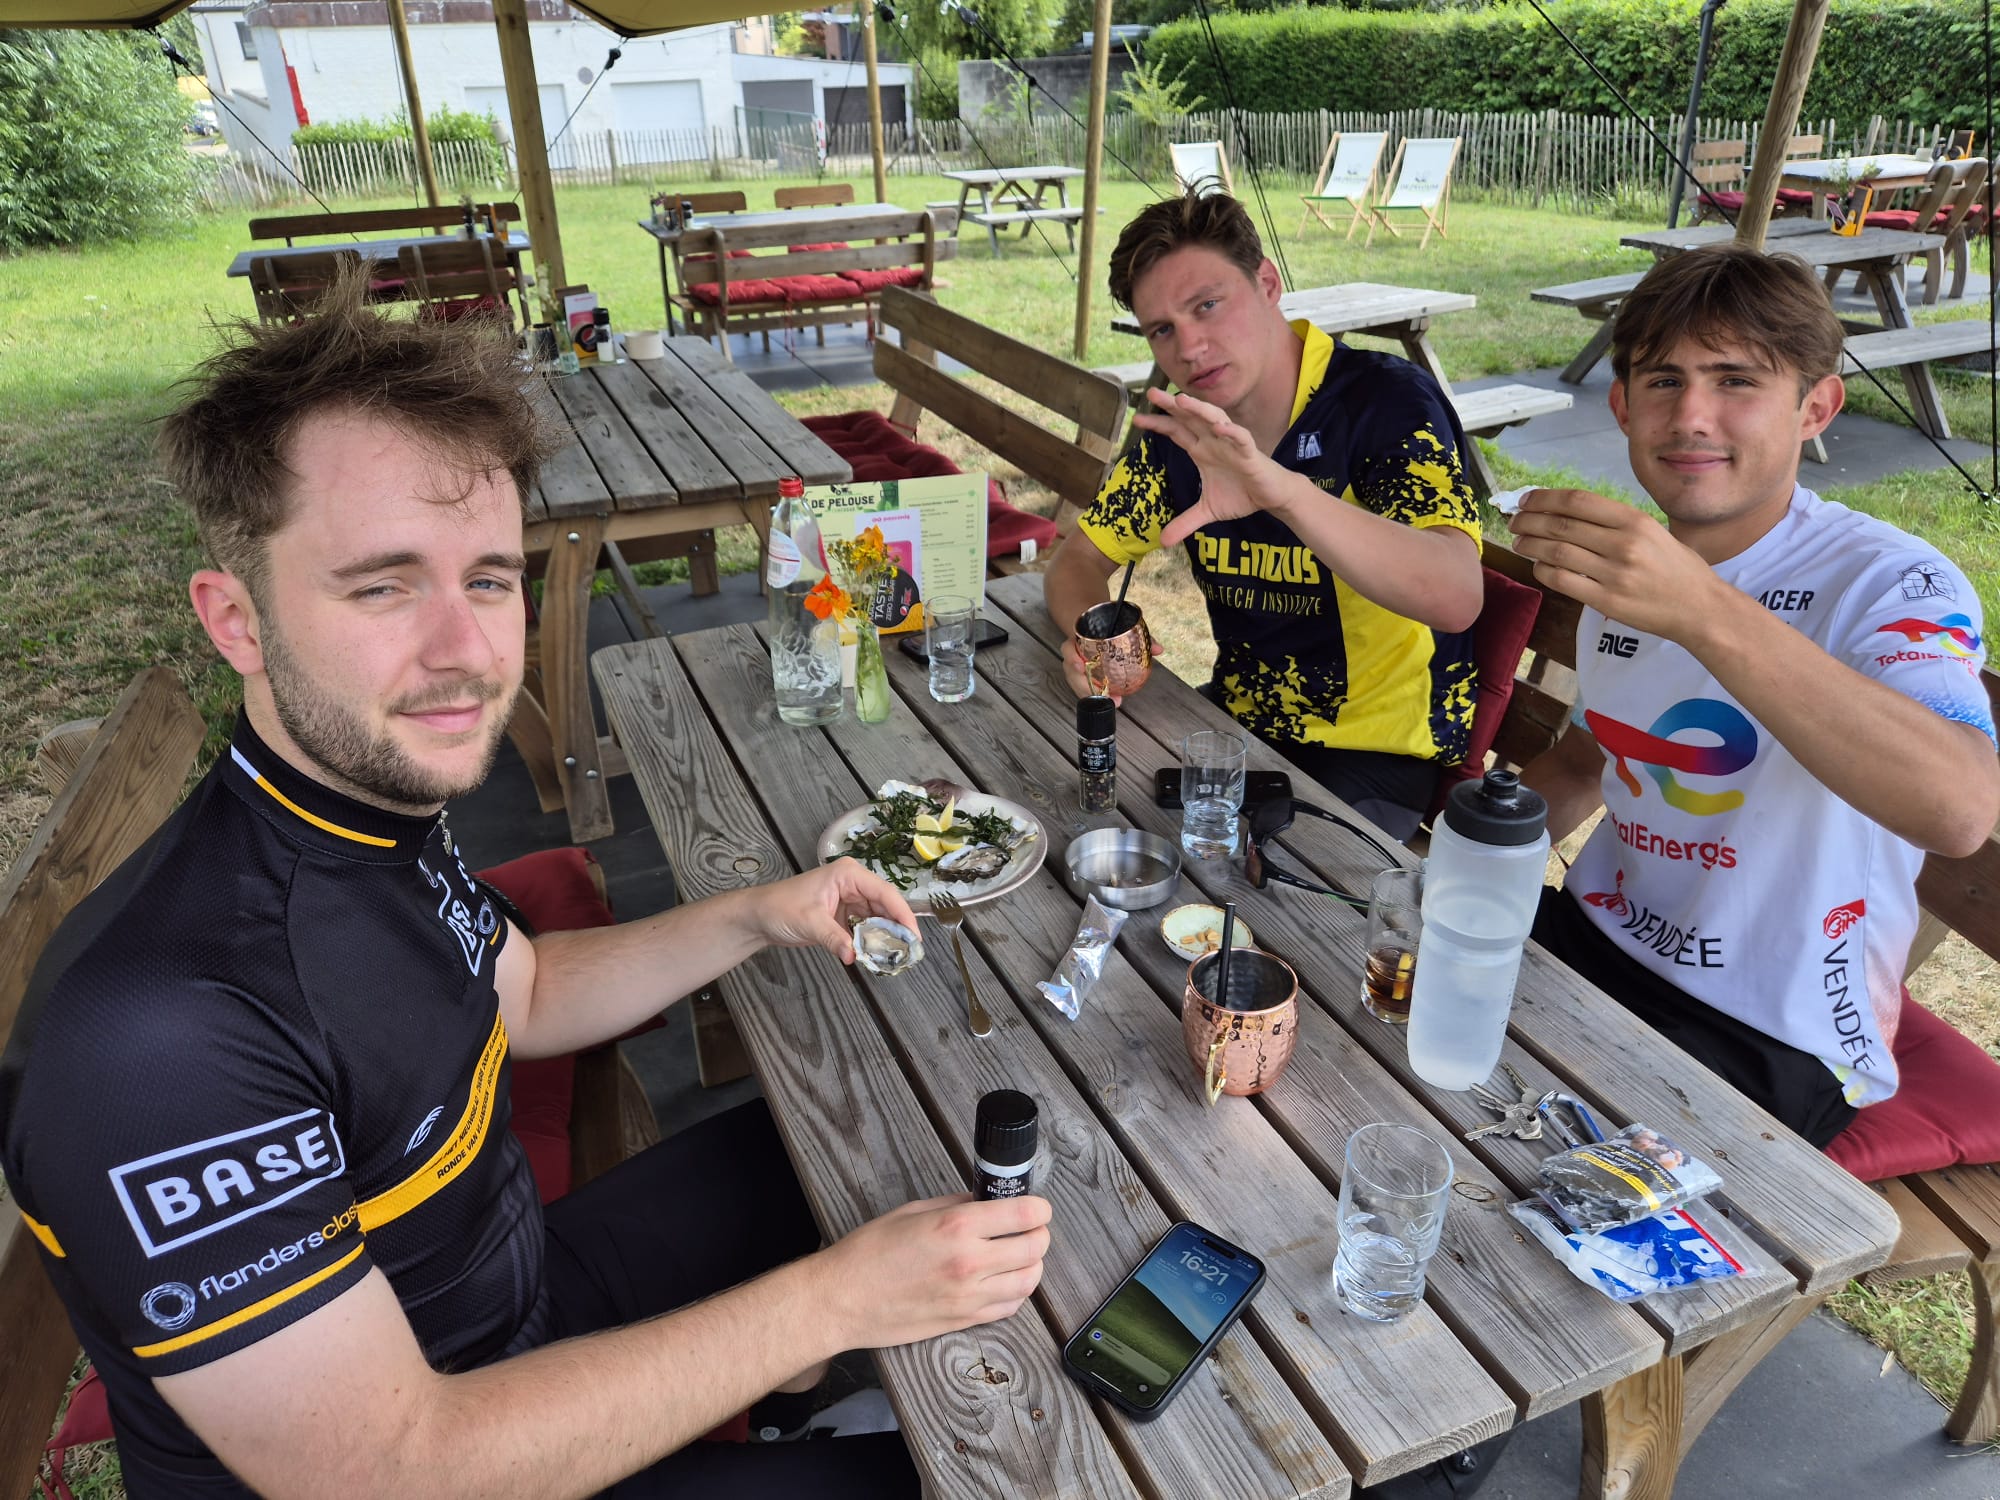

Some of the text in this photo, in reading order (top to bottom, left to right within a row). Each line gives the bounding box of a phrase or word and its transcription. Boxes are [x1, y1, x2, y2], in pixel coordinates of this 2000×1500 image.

[811, 499, 825, 509] DE
[827, 495, 875, 511] PELOUSE
[874, 578, 888, 620] TASTE
[885, 601, 893, 622] ZERO
[1755, 589, 1815, 611] ACER
[1621, 899, 1725, 968] VENDÉE
[1823, 938, 1877, 1071] VENDÉE
[145, 1126, 331, 1226] BASE
[436, 1149, 467, 1179] RONDE
[466, 1132, 478, 1151] VAN
[198, 1203, 358, 1300] flandersclas
[1179, 1250, 1229, 1286] 16:21
